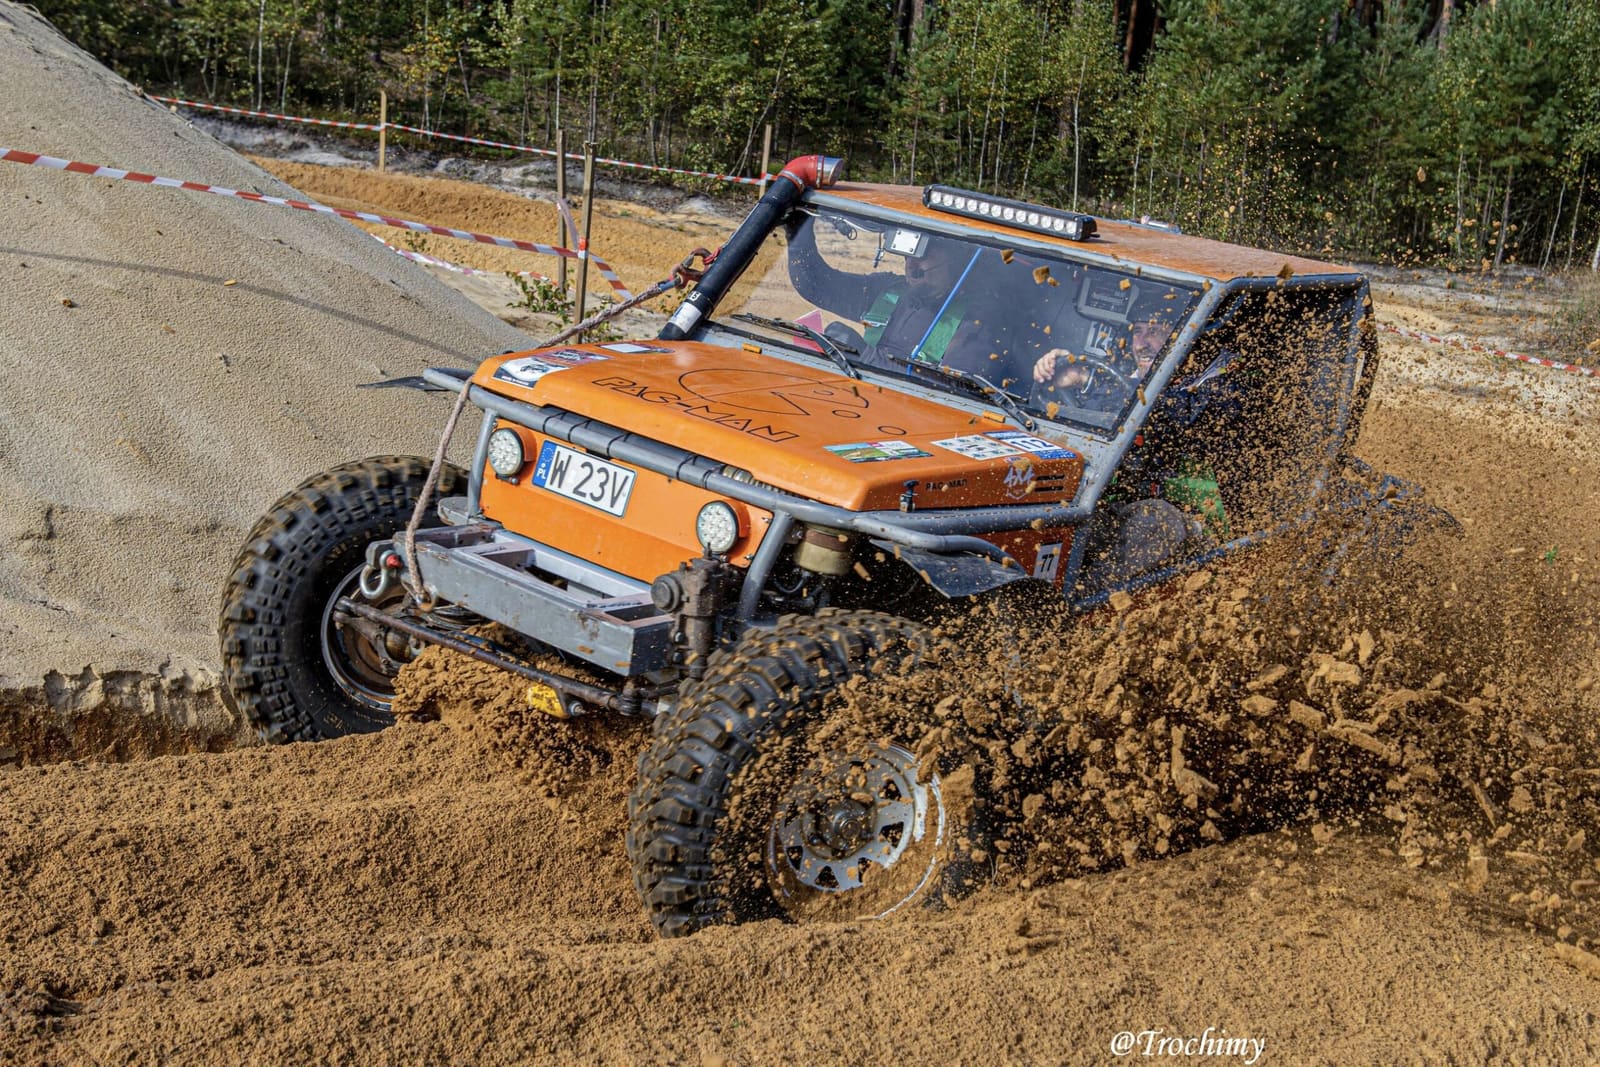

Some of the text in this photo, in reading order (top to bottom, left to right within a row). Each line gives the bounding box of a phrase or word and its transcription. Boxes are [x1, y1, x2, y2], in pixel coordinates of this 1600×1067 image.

[591, 376, 800, 443] PAC-MAN
[1010, 439, 1054, 450] 112
[536, 467, 547, 480] PL
[549, 450, 629, 509] W 23V
[925, 479, 968, 490] PACMAN
[1040, 553, 1056, 573] 77
